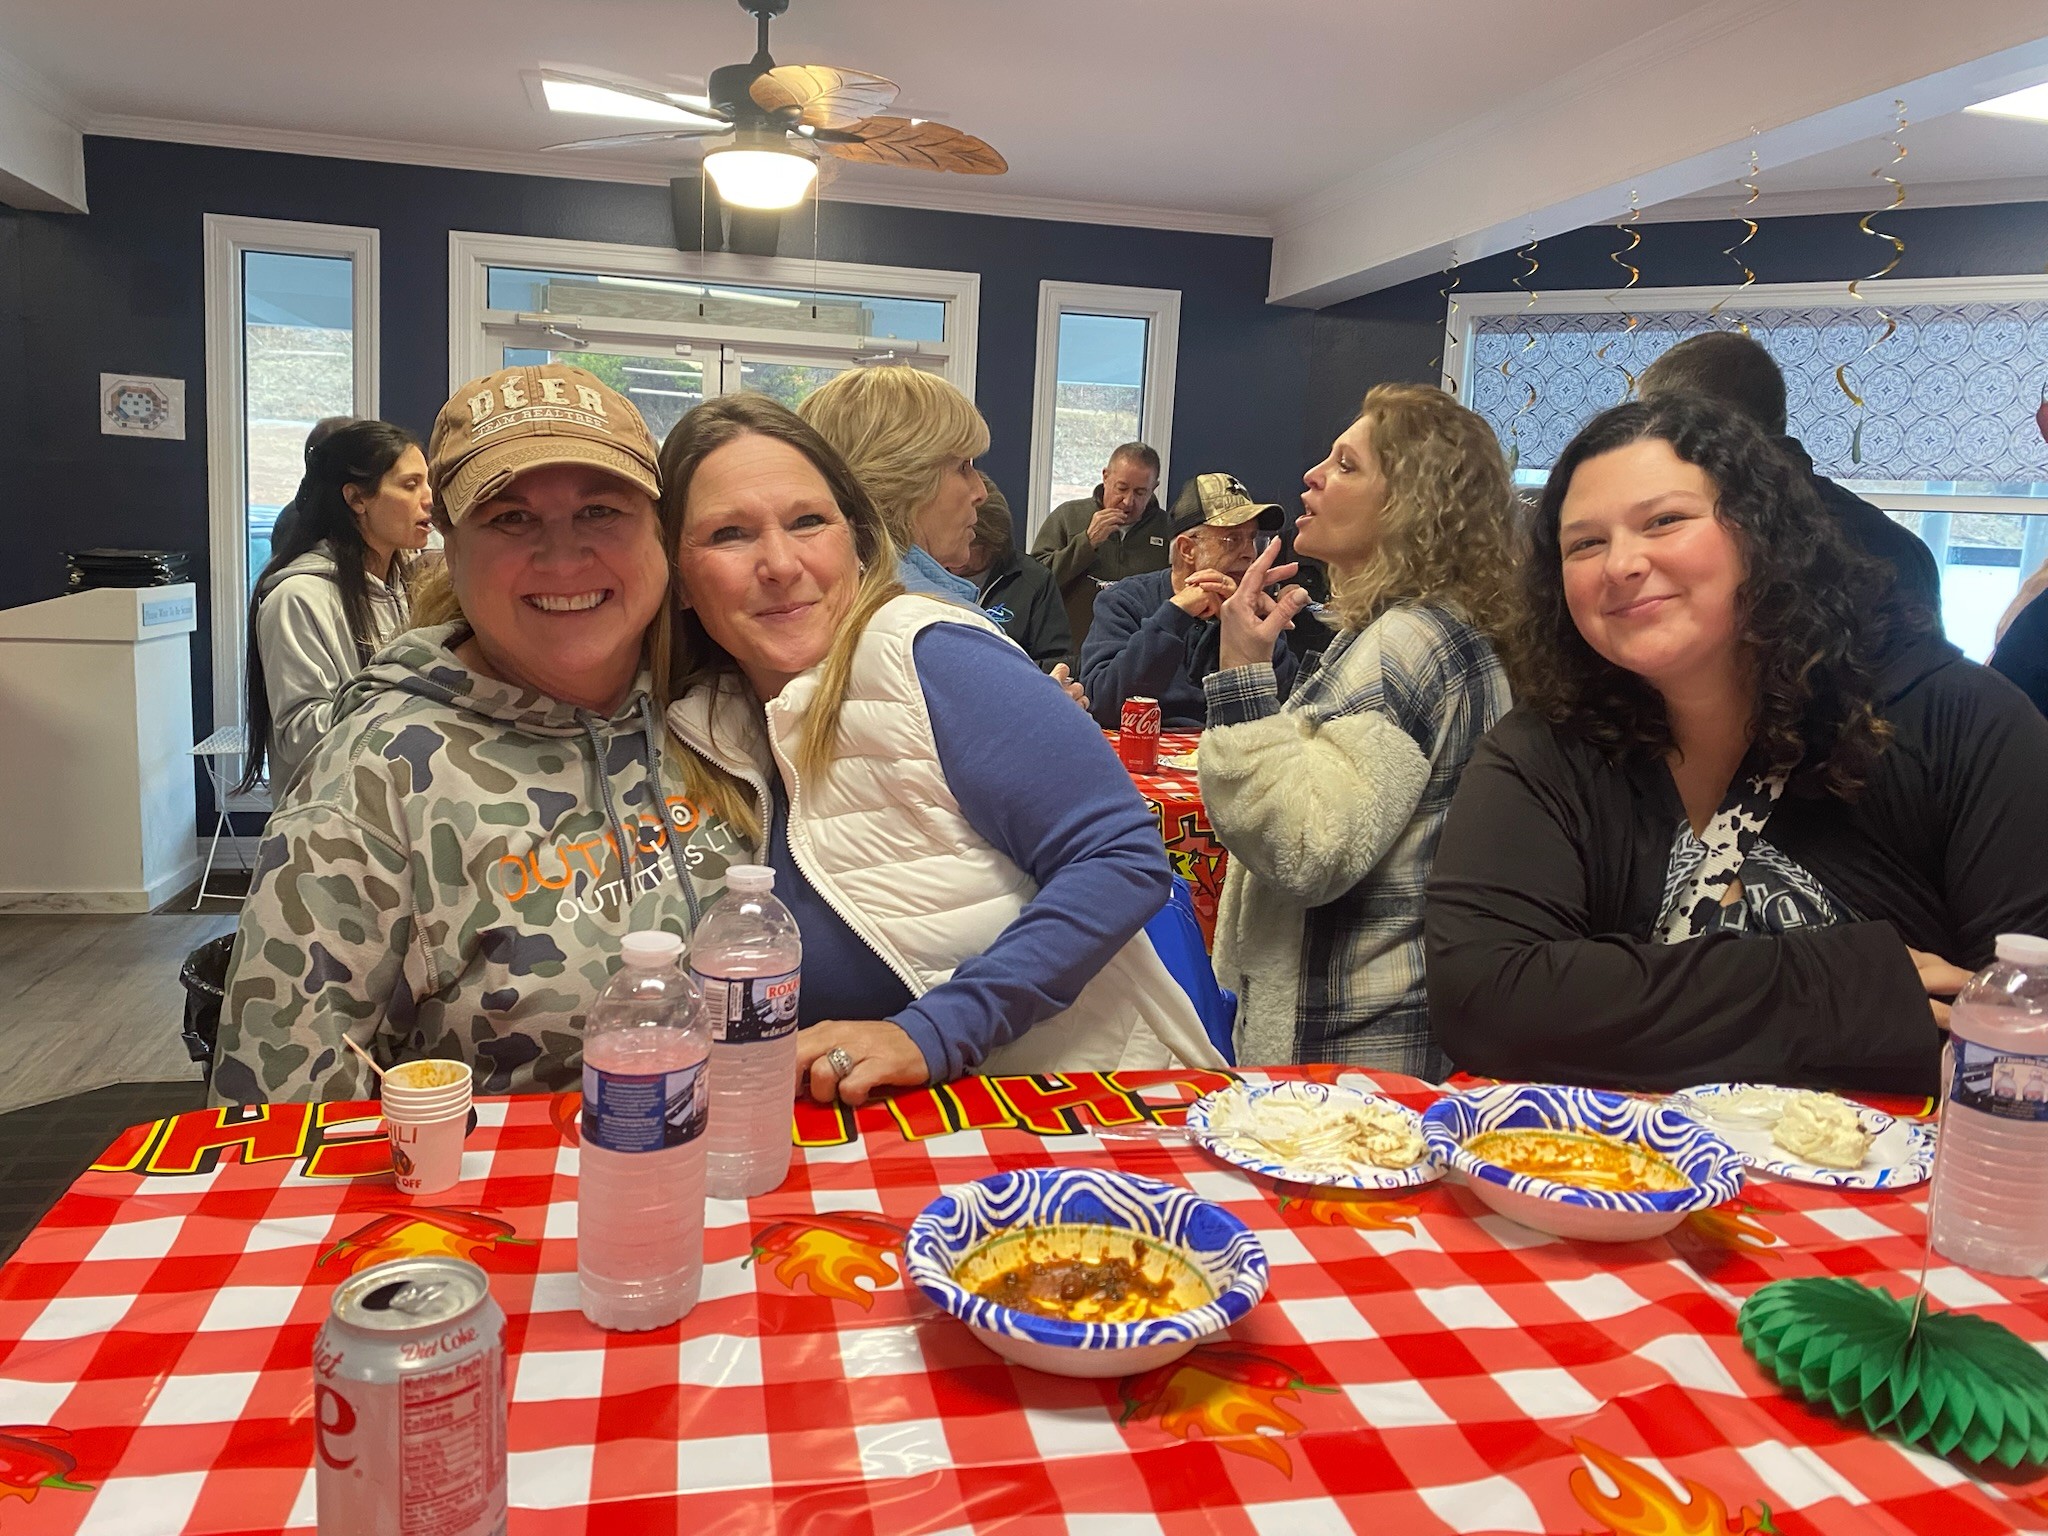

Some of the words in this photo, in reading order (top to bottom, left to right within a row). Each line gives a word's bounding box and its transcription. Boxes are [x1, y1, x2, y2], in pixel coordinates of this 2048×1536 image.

[467, 375, 607, 426] DEER
[478, 414, 516, 436] TEAM
[521, 408, 603, 428] REALTREE
[500, 795, 714, 902] OUTDOO
[387, 1123, 418, 1144] HILI
[402, 1177, 422, 1189] OFF
[400, 1339, 438, 1361] Diet
[440, 1327, 477, 1353] Coke
